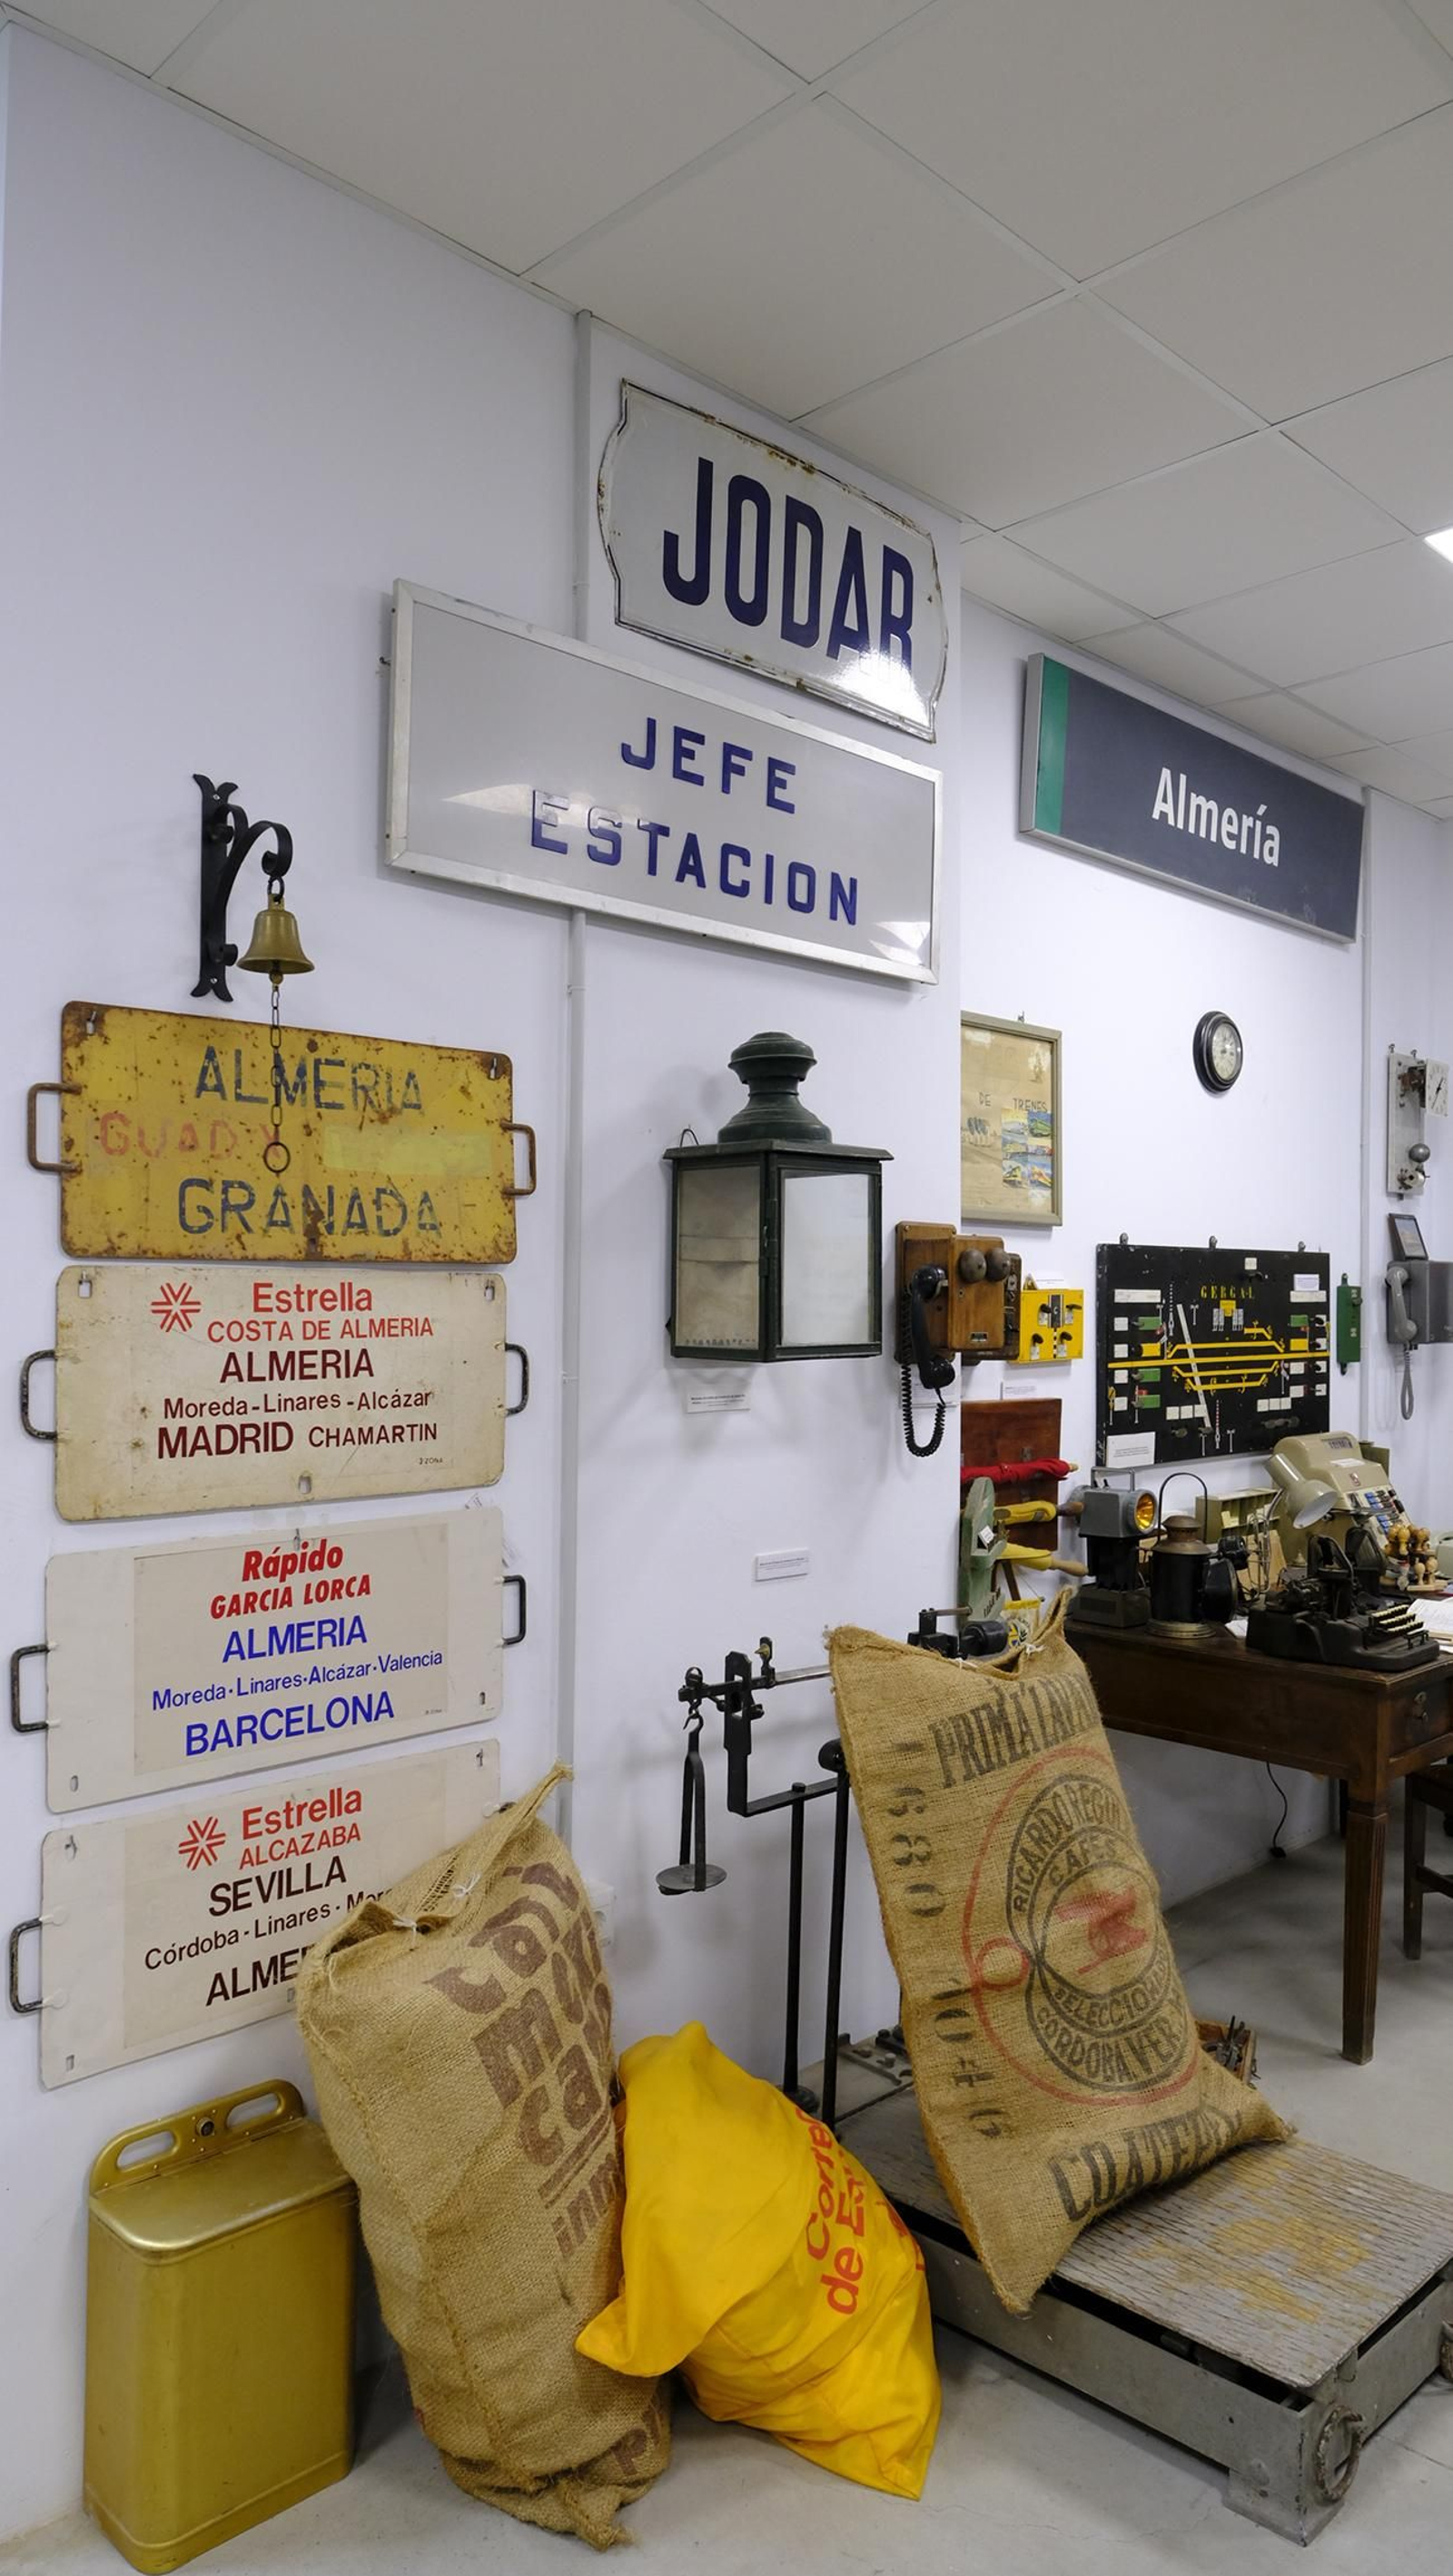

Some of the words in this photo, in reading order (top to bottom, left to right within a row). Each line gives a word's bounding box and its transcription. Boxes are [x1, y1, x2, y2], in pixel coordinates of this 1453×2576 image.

[663, 457, 914, 681] JODAR
[621, 717, 796, 814] JEFE
[1152, 767, 1280, 867] Almería
[531, 789, 858, 926] ESTACION
[194, 1045, 425, 1114] ALMERIA
[179, 1178, 441, 1238] GRANADA
[252, 1282, 372, 1313] Estrella
[207, 1320, 292, 1343] COSTA
[302, 1319, 331, 1340] DE
[341, 1318, 433, 1338] ALMERIA
[220, 1348, 374, 1384] ALMERIA
[158, 1421, 293, 1459] MADRID
[309, 1423, 437, 1447] CHAMARTIN
[242, 1539, 343, 1583] Rápido
[210, 1586, 293, 1620] GARCIA
[303, 1574, 371, 1606] LORCA
[222, 1615, 367, 1663] ALMERIA
[186, 1690, 394, 1756] BARCELONA
[242, 1787, 362, 1840] Estrella
[239, 1822, 361, 1870] ALCAZABA
[209, 1855, 347, 1917] SEVILLA
[206, 1945, 316, 2007] ALME
[820, 2246, 865, 2315] de
